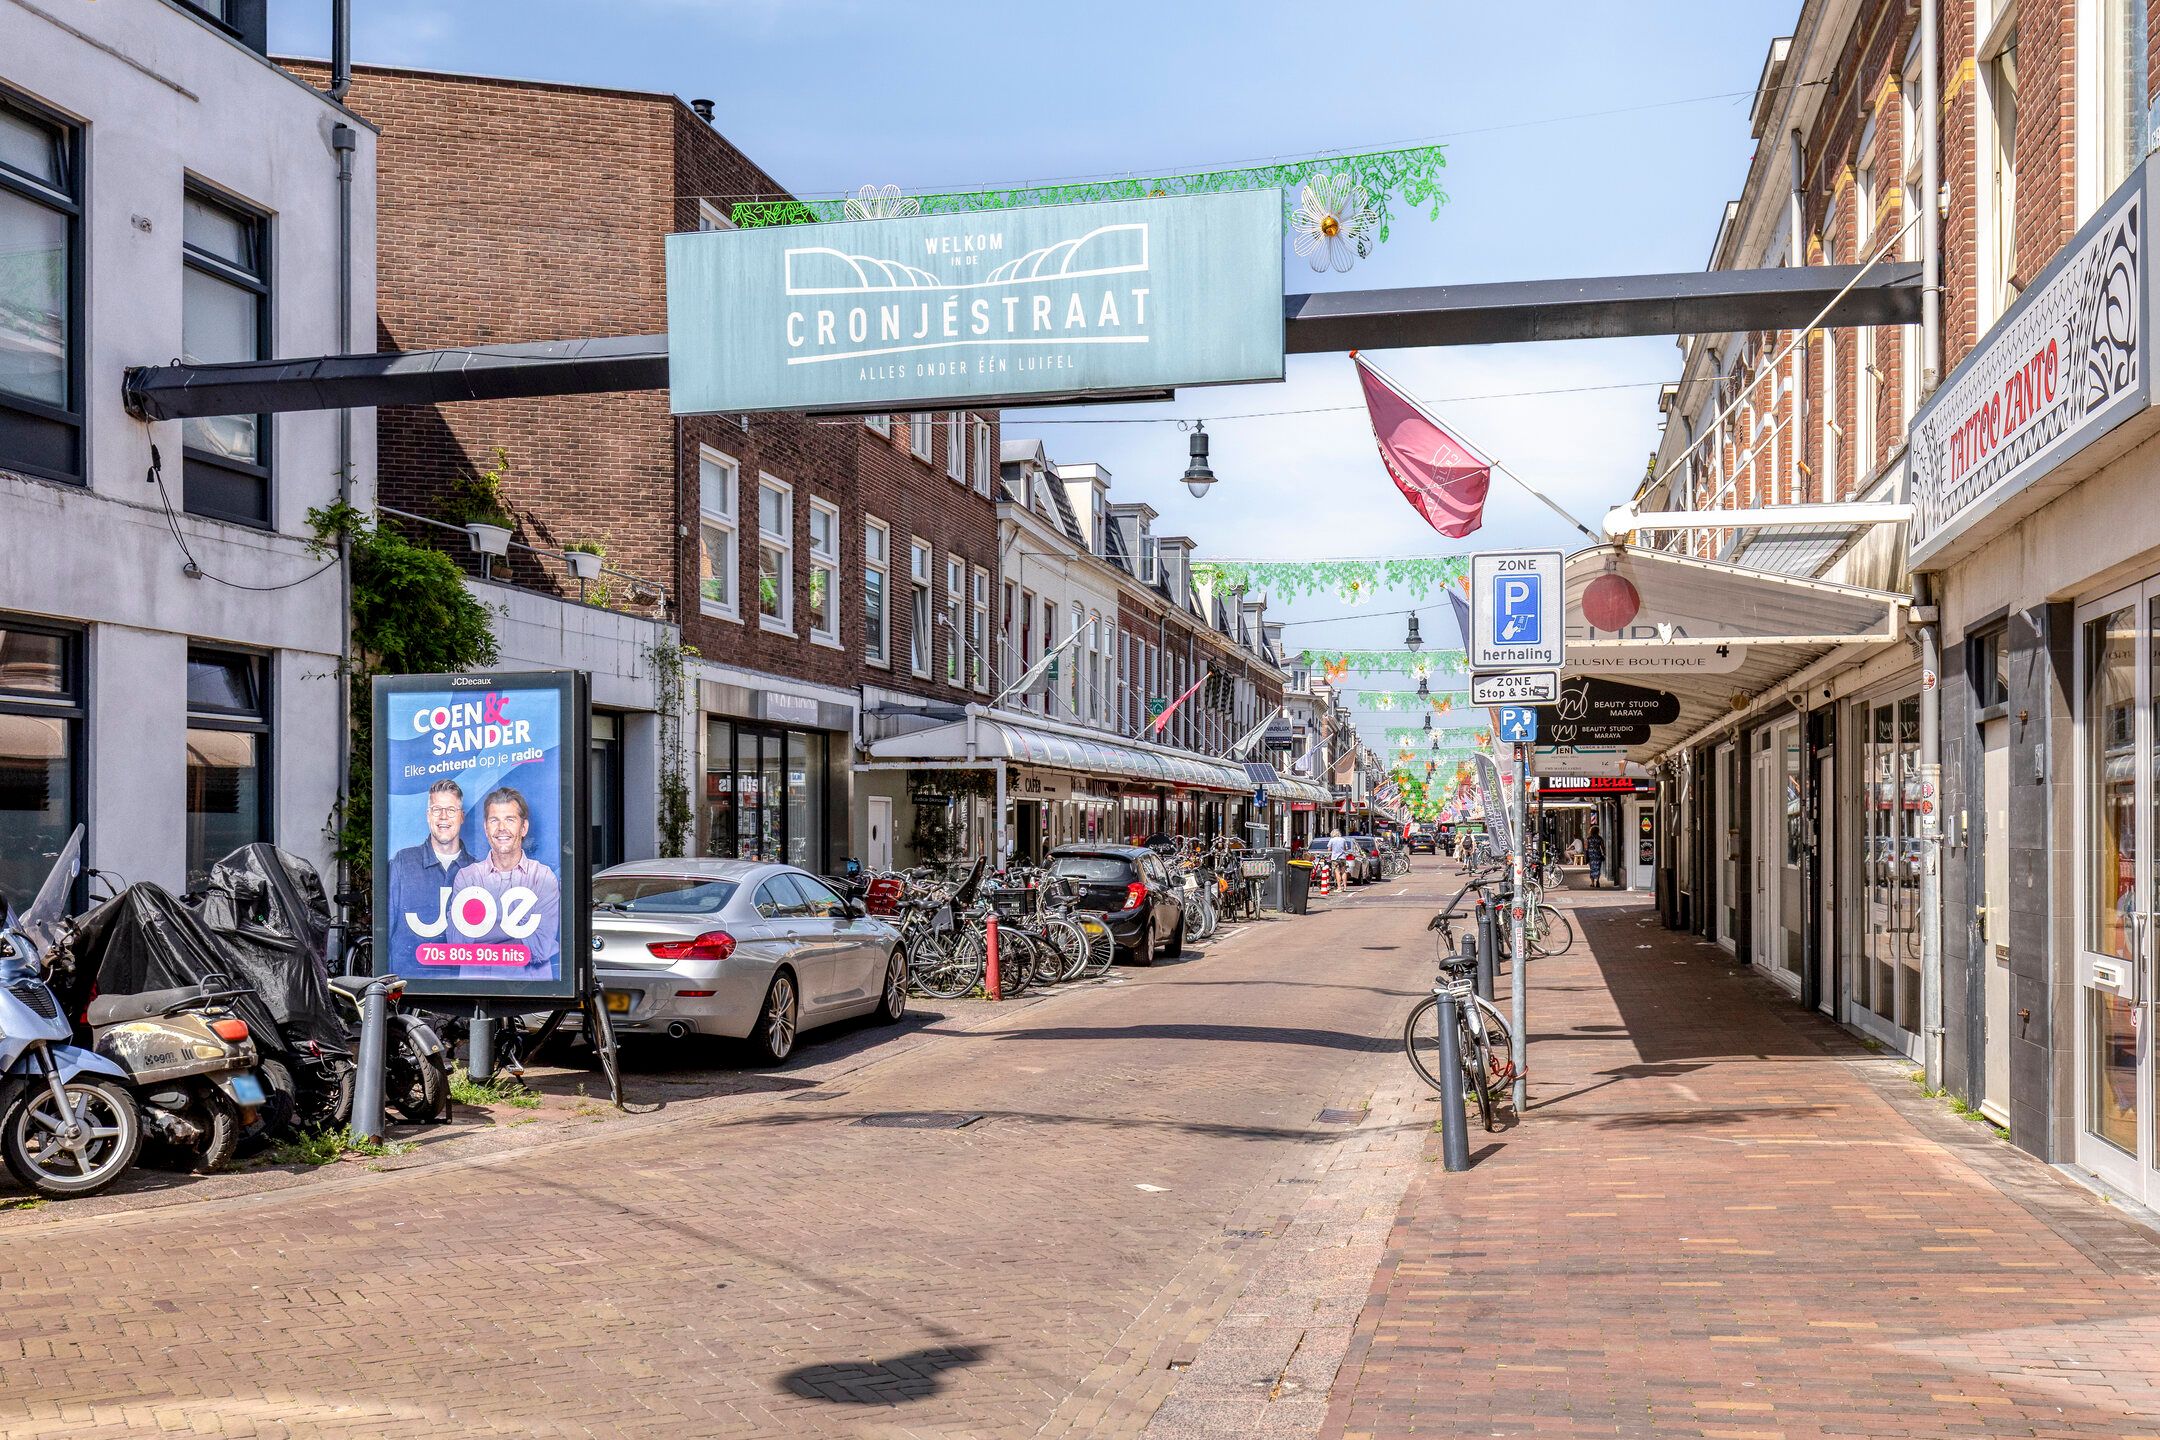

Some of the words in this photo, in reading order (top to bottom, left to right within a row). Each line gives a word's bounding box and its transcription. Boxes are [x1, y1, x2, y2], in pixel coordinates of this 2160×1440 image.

[925, 233, 1003, 254] WELKOM
[951, 256, 961, 266] IN
[966, 255, 978, 265] DE
[786, 288, 1150, 347] CRONJÉSTRAAT
[859, 365, 905, 381] ALLES
[917, 361, 967, 377] ONDER
[979, 355, 1006, 374] ÉÉN
[1018, 355, 1074, 371] LUIFEL
[1950, 391, 2001, 484] TATTOO
[2003, 337, 2059, 438] ZANTO
[1498, 560, 1537, 571] ZONE
[1505, 581, 1530, 615] P
[1483, 648, 1552, 662] herhaling
[1715, 645, 1730, 658] 4
[1565, 658, 1625, 667] CLUSIVE
[1628, 657, 1706, 667] BOUTIQUE
[451, 677, 492, 686] JCDecaux
[1496, 676, 1531, 687] ZONE
[1479, 688, 1505, 700] Stop
[1508, 687, 1516, 697] &
[1520, 686, 1539, 697] Sh
[1594, 700, 1626, 708] BEAUTY
[1629, 700, 1659, 708] STUDIO
[413, 701, 485, 734] COEN
[483, 692, 511, 726] &
[1503, 710, 1516, 725] P
[1609, 709, 1643, 717] MARAYA
[432, 720, 531, 756] SANDER
[404, 764, 426, 778] Elke
[428, 757, 477, 775] ochtend
[479, 755, 496, 768] op
[497, 752, 509, 766] je
[511, 748, 543, 764] radio
[422, 948, 446, 961] 70s
[449, 948, 473, 961] 80s
[476, 948, 499, 962] 90s
[502, 948, 525, 962] hits
